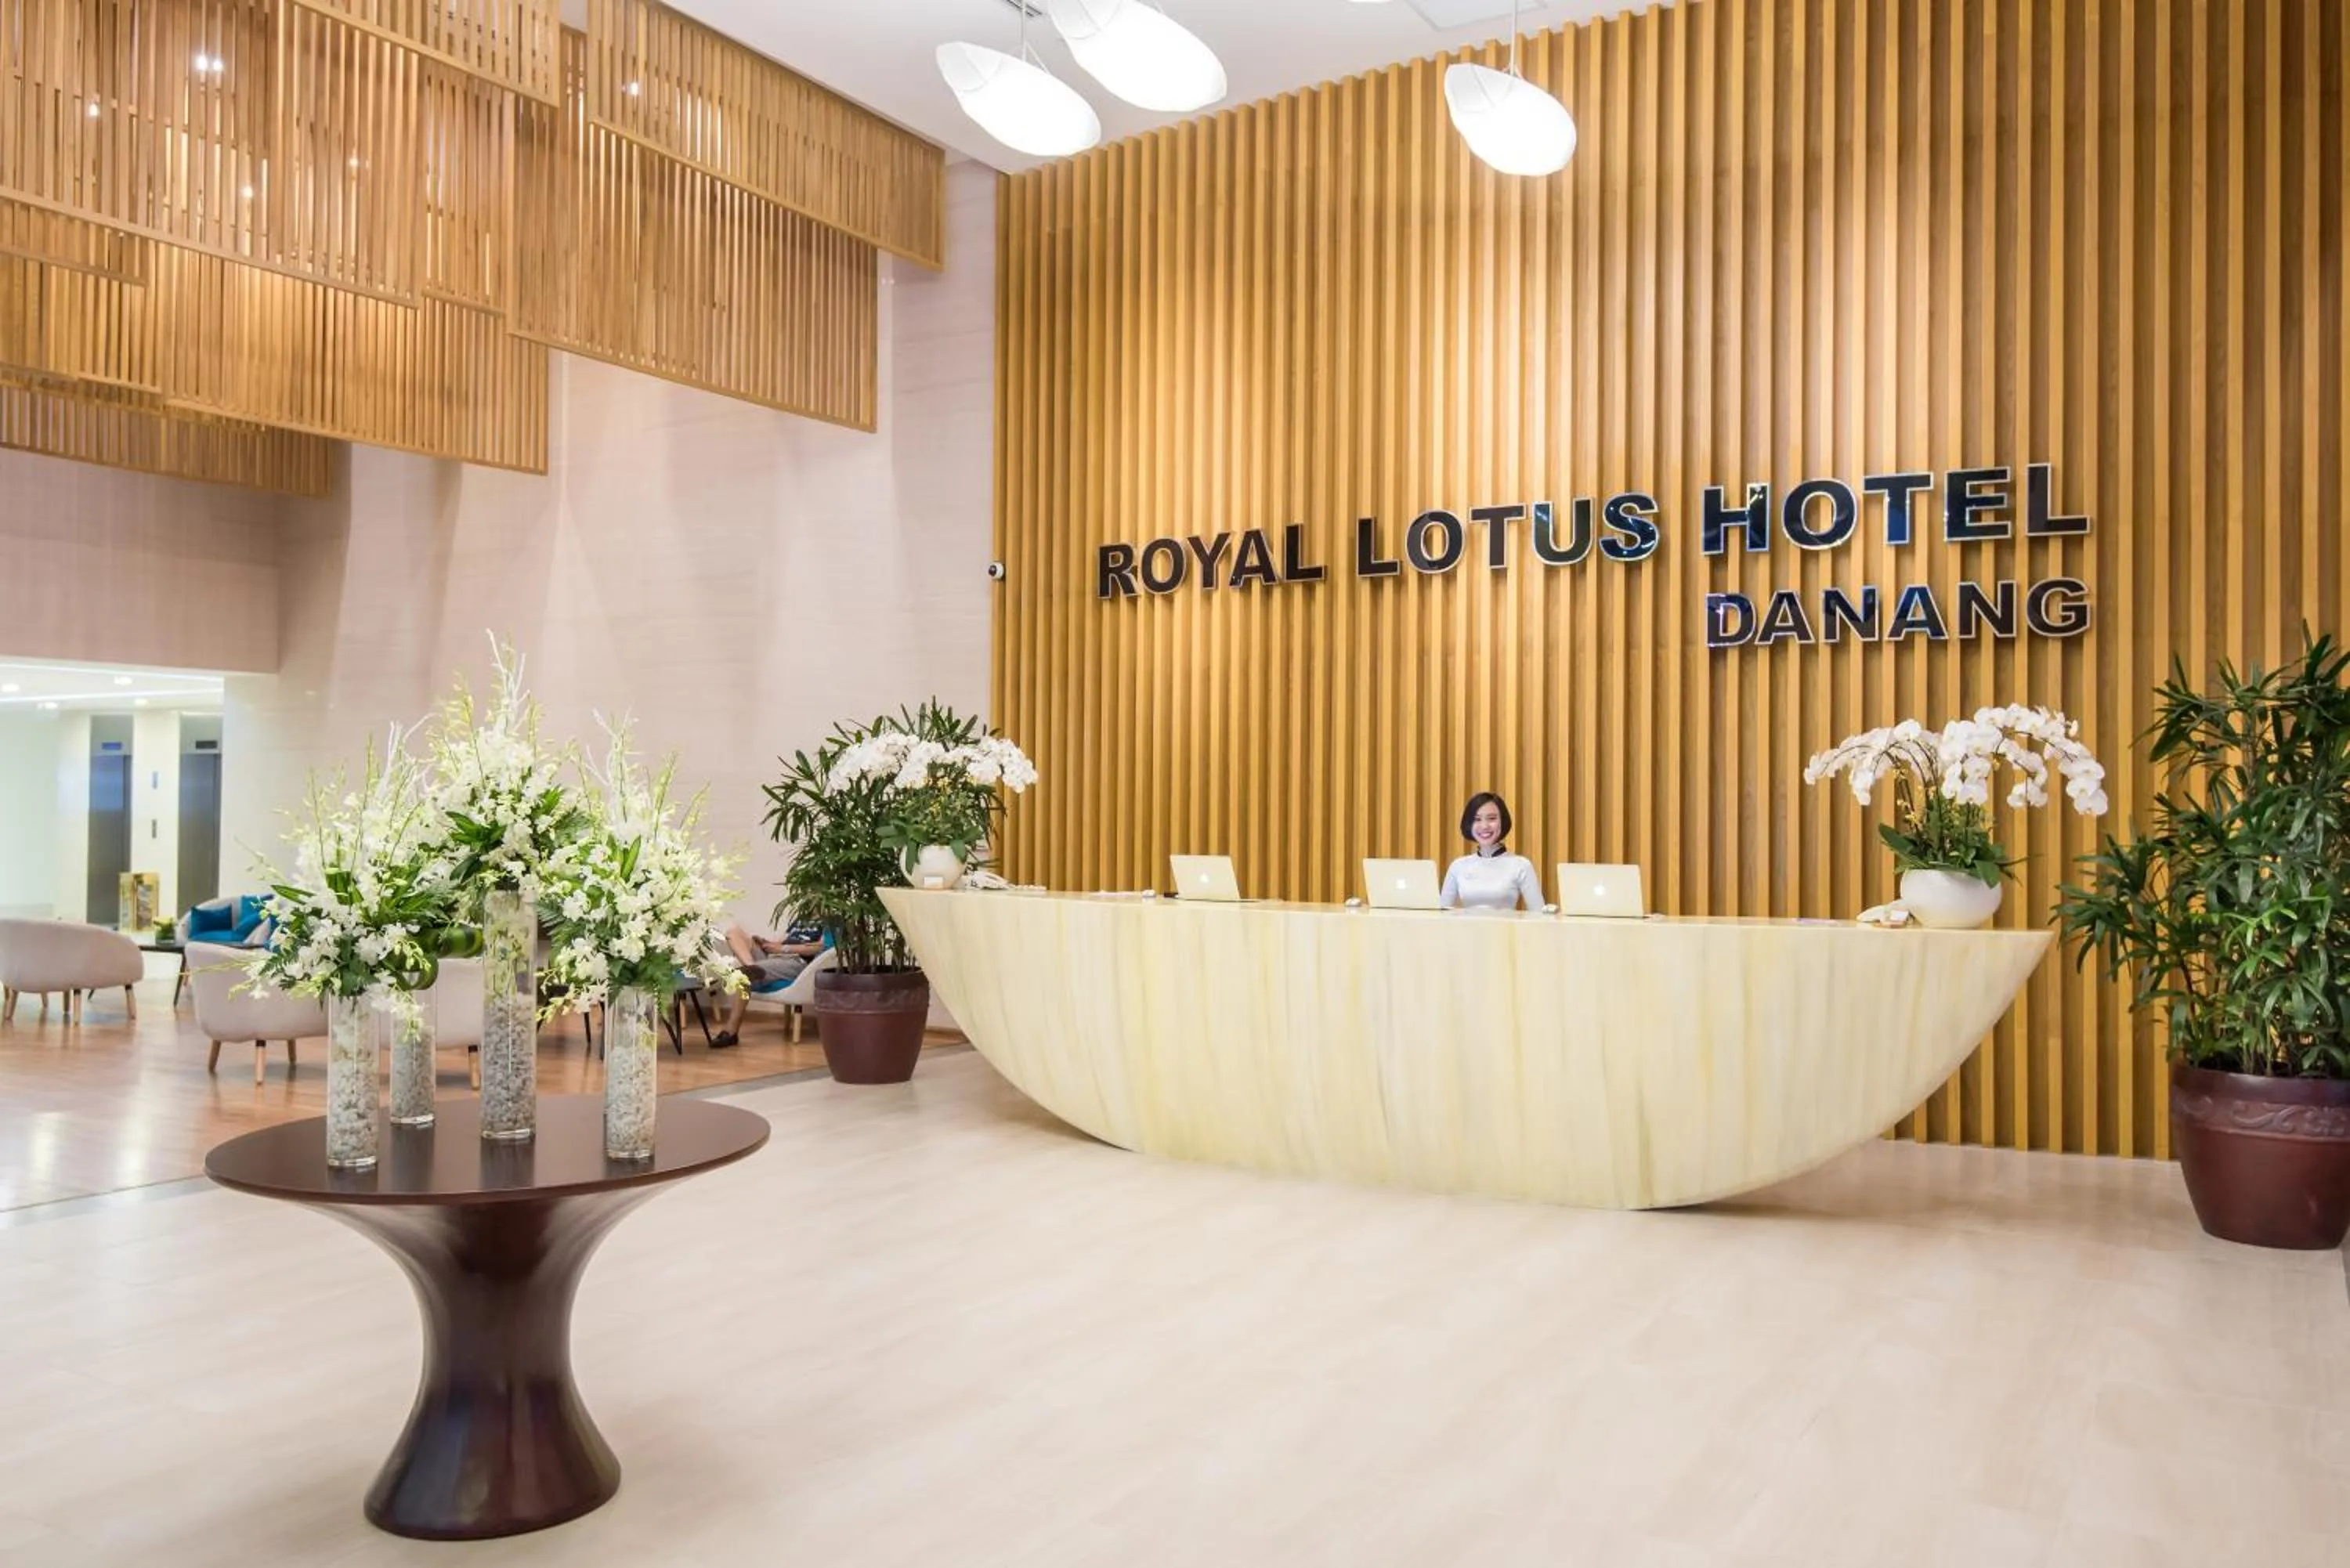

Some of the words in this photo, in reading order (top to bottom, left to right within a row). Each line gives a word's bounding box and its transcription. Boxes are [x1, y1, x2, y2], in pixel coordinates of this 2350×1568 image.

[1097, 523, 1326, 599] ROYAL
[1355, 492, 1660, 578] LOTUS
[1701, 463, 2091, 555] HOTEL
[1705, 577, 2091, 649] DANANG
